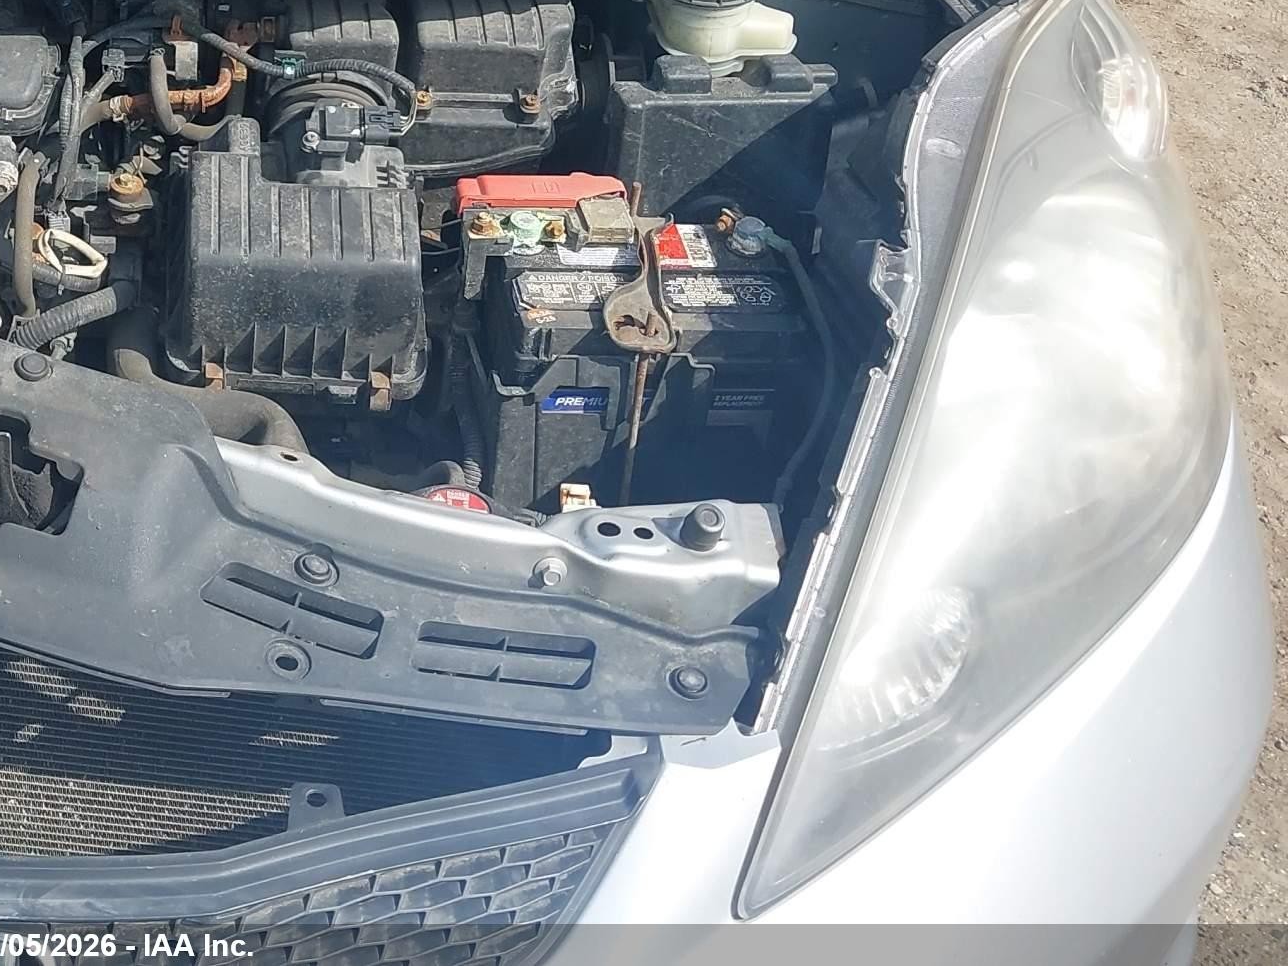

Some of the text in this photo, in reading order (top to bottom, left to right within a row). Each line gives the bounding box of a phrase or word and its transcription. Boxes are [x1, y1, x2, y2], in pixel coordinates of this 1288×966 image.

[538, 275, 578, 283] DANGER
[588, 274, 625, 283] POISON
[554, 397, 610, 407] PREMIU
